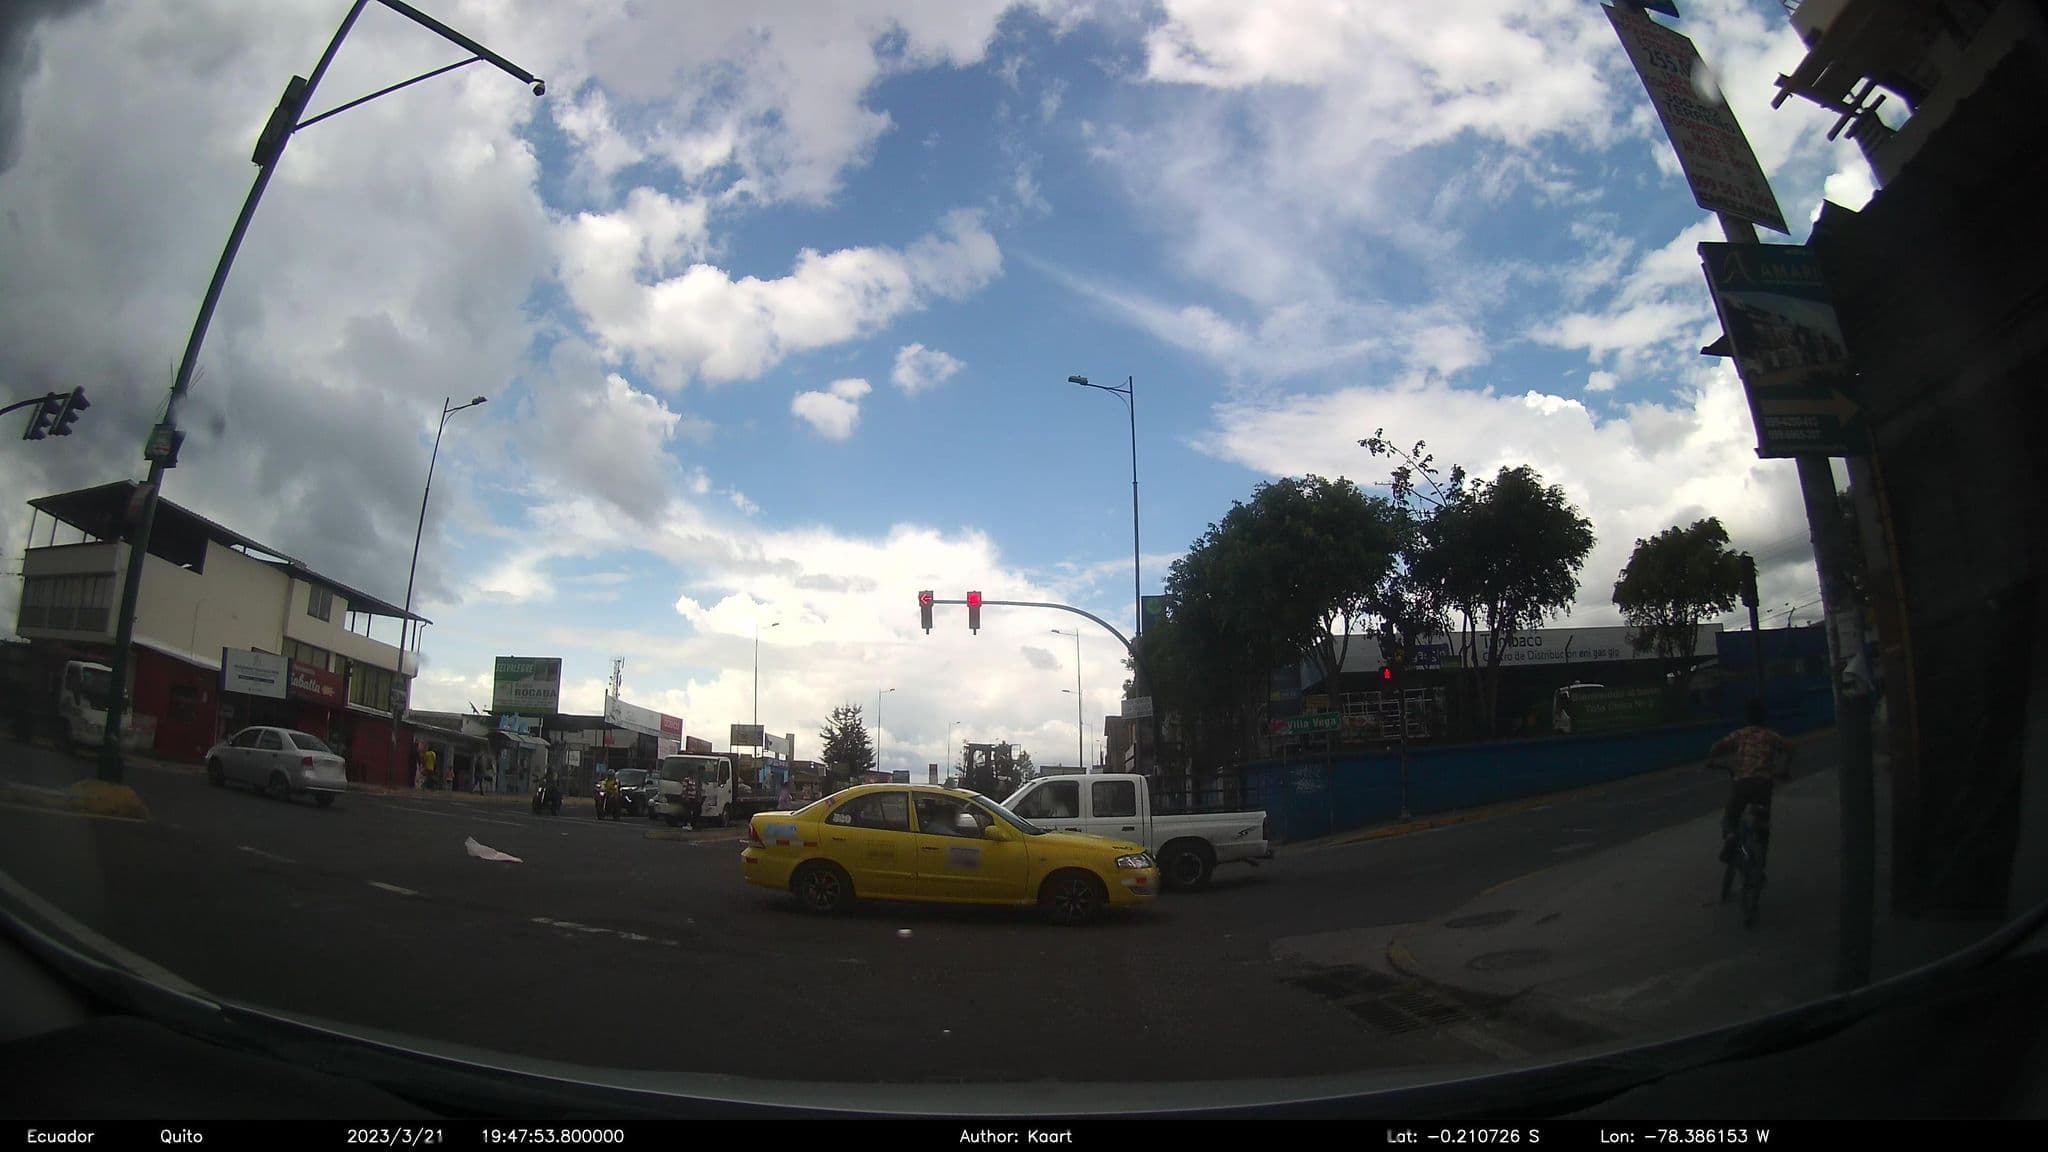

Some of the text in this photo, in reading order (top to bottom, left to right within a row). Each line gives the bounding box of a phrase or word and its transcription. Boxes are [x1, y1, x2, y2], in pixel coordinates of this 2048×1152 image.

[1480, 634, 1543, 650] Tmbaco
[1287, 716, 1337, 729] Villa Vega
